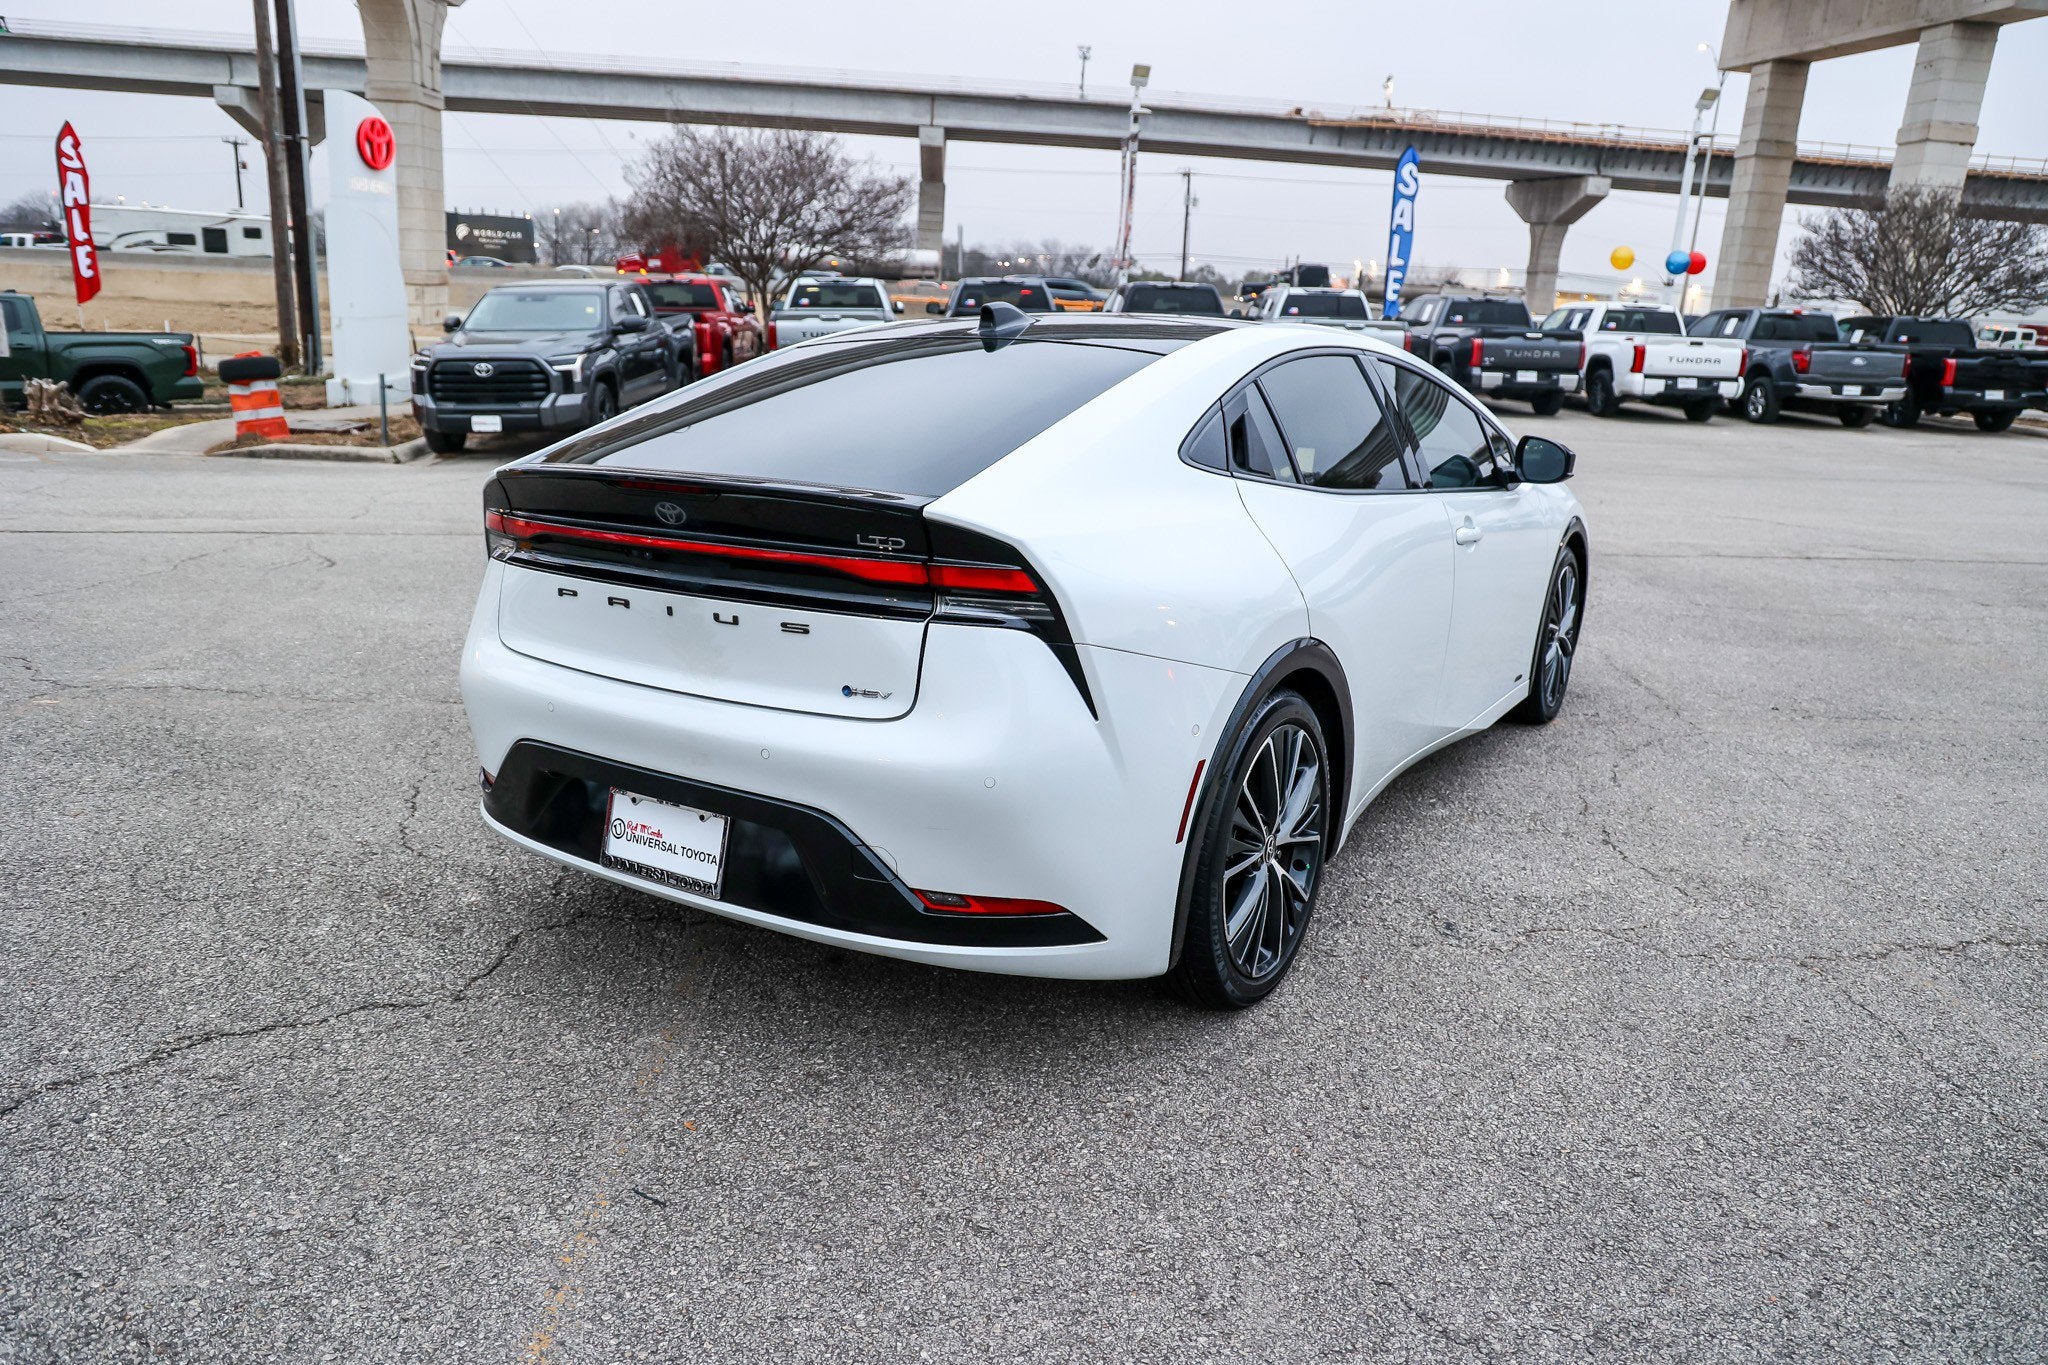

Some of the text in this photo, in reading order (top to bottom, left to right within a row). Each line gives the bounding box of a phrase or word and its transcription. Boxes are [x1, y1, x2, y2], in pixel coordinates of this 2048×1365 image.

[60, 135, 95, 278] SALE
[1386, 162, 1419, 301] SALE
[1505, 349, 1560, 359] TUNDRA
[1668, 355, 1721, 365] TUNDRA
[856, 534, 906, 549] LTD
[557, 587, 810, 635] PRIUS
[625, 831, 718, 866] UNIVERSAL TOYOTA
[675, 873, 717, 896] TOYOTA
